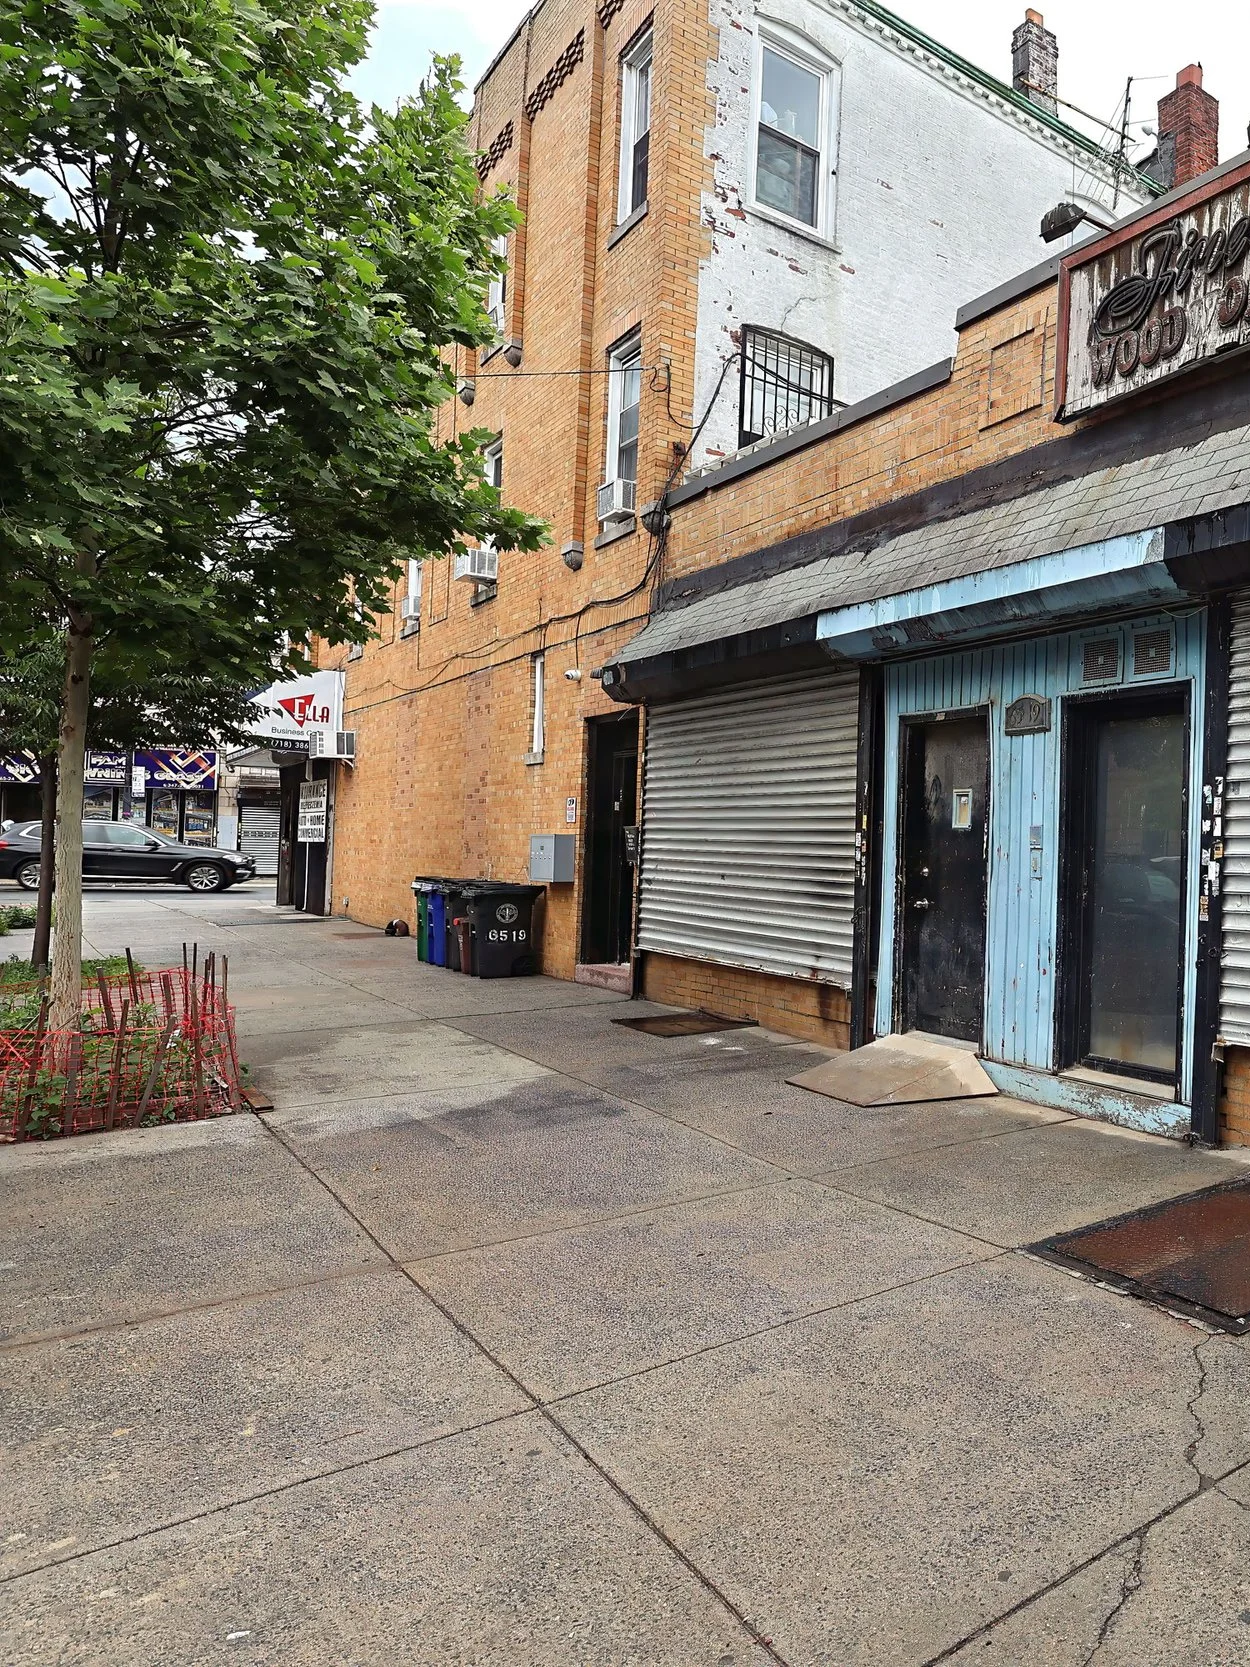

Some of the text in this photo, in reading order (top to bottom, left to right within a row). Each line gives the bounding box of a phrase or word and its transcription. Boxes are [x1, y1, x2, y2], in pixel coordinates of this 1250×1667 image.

[1091, 305, 1188, 388] WOOD
[293, 698, 330, 723] ELLA
[271, 726, 305, 736] Business
[271, 741, 292, 749] (718)
